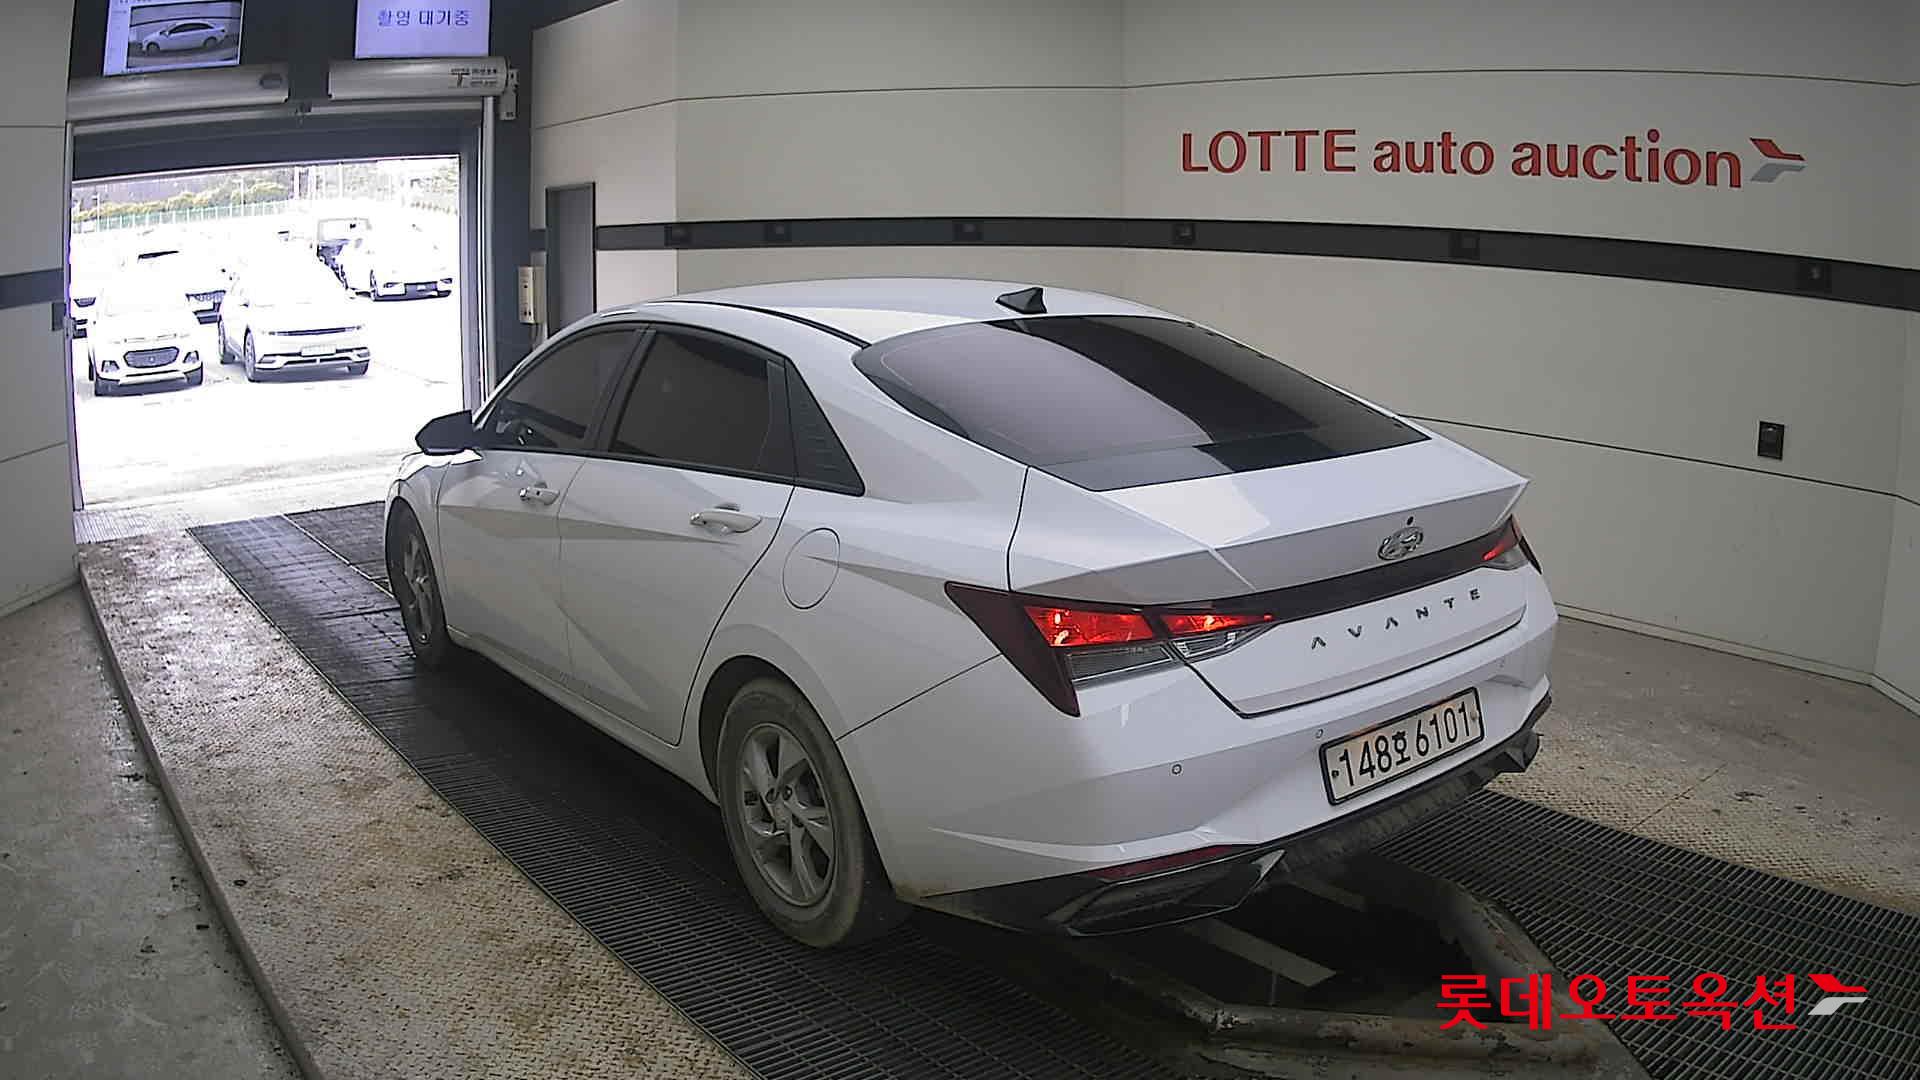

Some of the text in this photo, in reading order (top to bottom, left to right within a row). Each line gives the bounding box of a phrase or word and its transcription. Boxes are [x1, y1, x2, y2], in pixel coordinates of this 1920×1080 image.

[418, 9, 469, 26] 대기중
[1182, 128, 1741, 188] LOTTE auto auction
[1311, 588, 1481, 650] AVANTE
